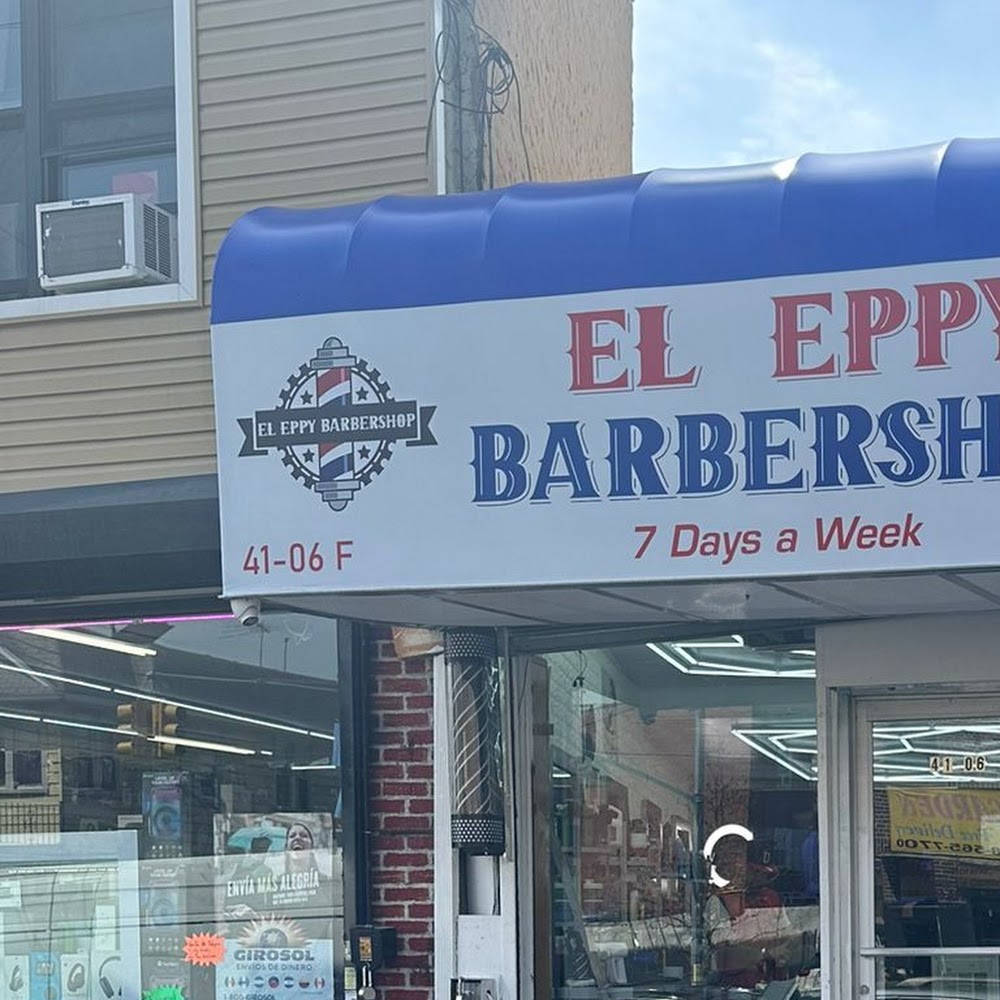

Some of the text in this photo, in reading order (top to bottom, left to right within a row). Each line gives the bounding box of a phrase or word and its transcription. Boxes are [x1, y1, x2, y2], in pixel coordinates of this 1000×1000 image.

[566, 305, 703, 395] EL
[257, 413, 417, 437] EL EPPY BARBERSHOP
[633, 513, 924, 565] 7 Days a Week
[243, 540, 353, 575] 41-06 F
[227, 867, 320, 897] ENVÍA MÁS ALEGRÍA
[233, 949, 315, 962] GIROSOL
